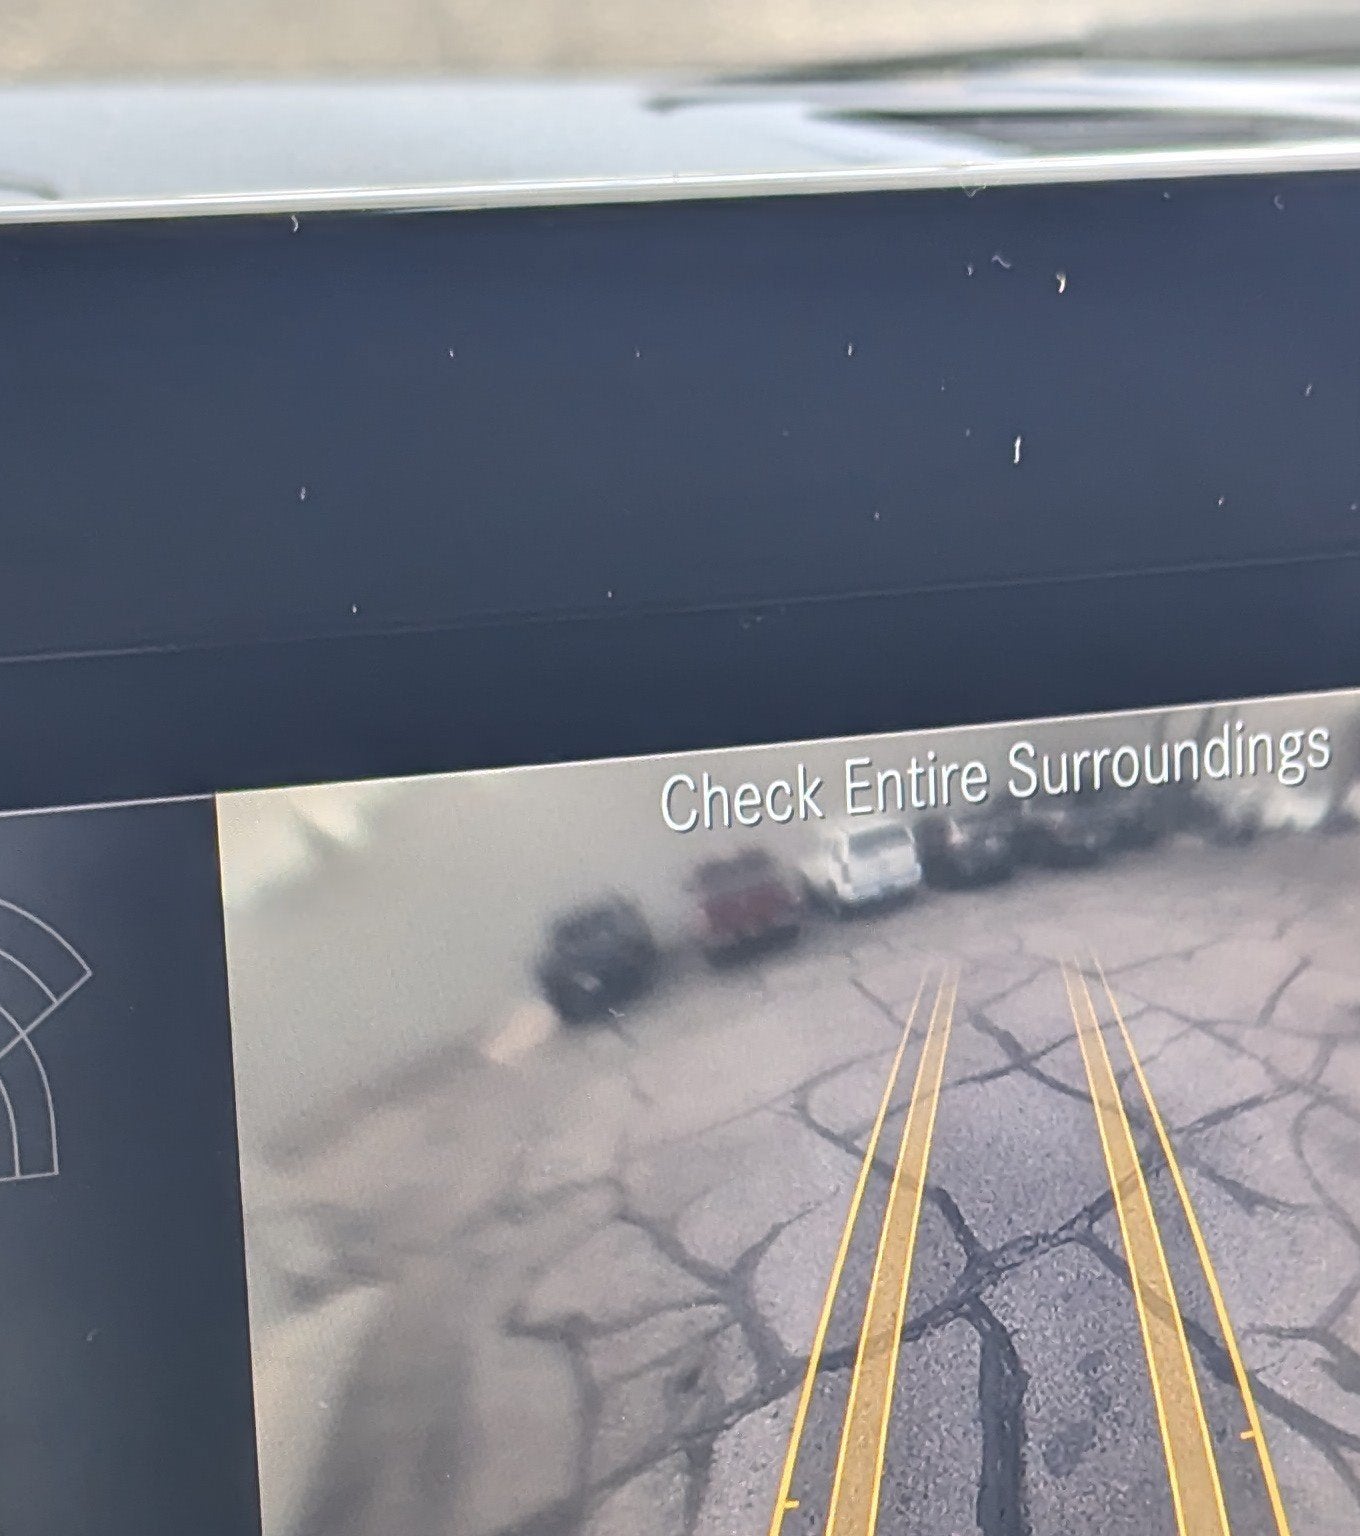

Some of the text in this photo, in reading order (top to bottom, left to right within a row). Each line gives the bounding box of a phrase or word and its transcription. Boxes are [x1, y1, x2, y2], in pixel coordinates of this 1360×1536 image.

[660, 721, 1332, 832] Check Entire Surroundings
